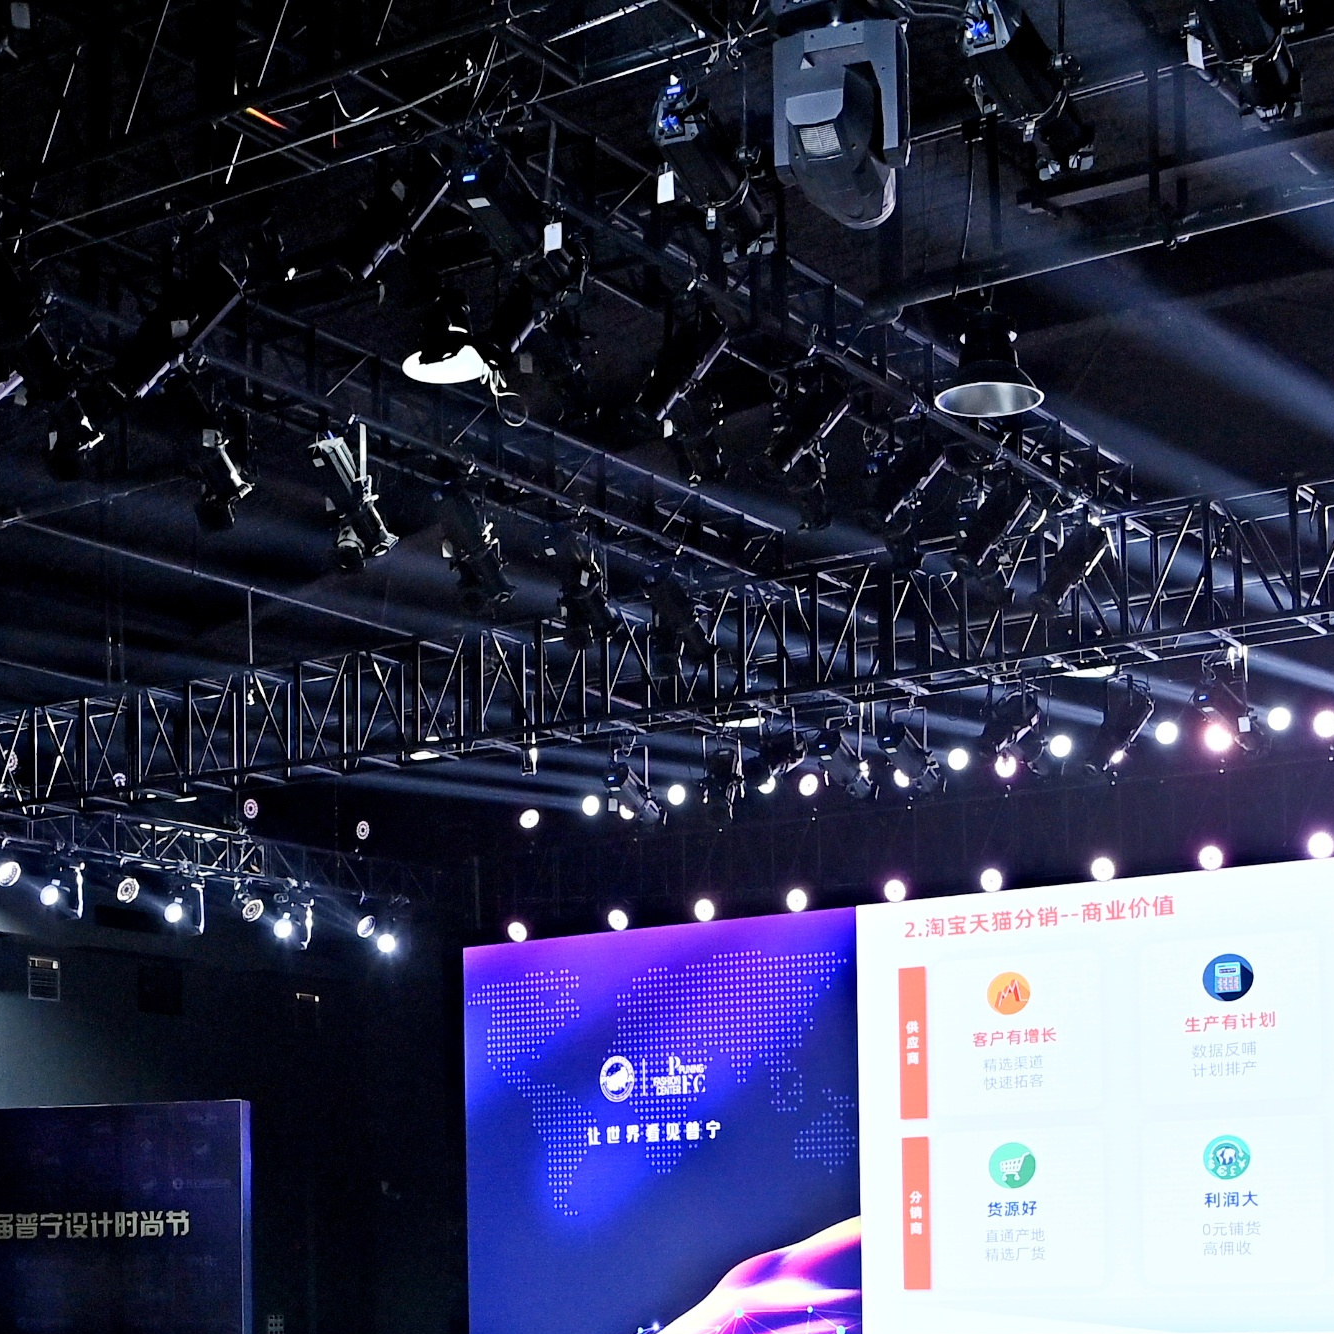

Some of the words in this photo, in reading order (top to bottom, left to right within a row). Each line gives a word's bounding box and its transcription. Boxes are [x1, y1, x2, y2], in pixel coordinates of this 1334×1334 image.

[1184, 1011, 1277, 1034] 生产有计划
[905, 1020, 920, 1066] 供应商
[972, 1027, 1057, 1048] 客户有增长
[1191, 1041, 1258, 1060] 数据反哺
[983, 1054, 1044, 1072] 精选渠道
[1191, 1060, 1258, 1079] 计划排产
[983, 1072, 1044, 1090] 快速拓客
[587, 1119, 721, 1146] 让世界看见普宁
[987, 1199, 1037, 1218] 货源好
[1204, 1190, 1259, 1209] 利润大
[909, 1190, 923, 1236] 分销商
[985, 1226, 1046, 1244] 直通产地
[1202, 1220, 1262, 1239] 0元铺货
[985, 1244, 1046, 1262] 精选厂货
[1203, 1239, 1252, 1257] 高佣收
